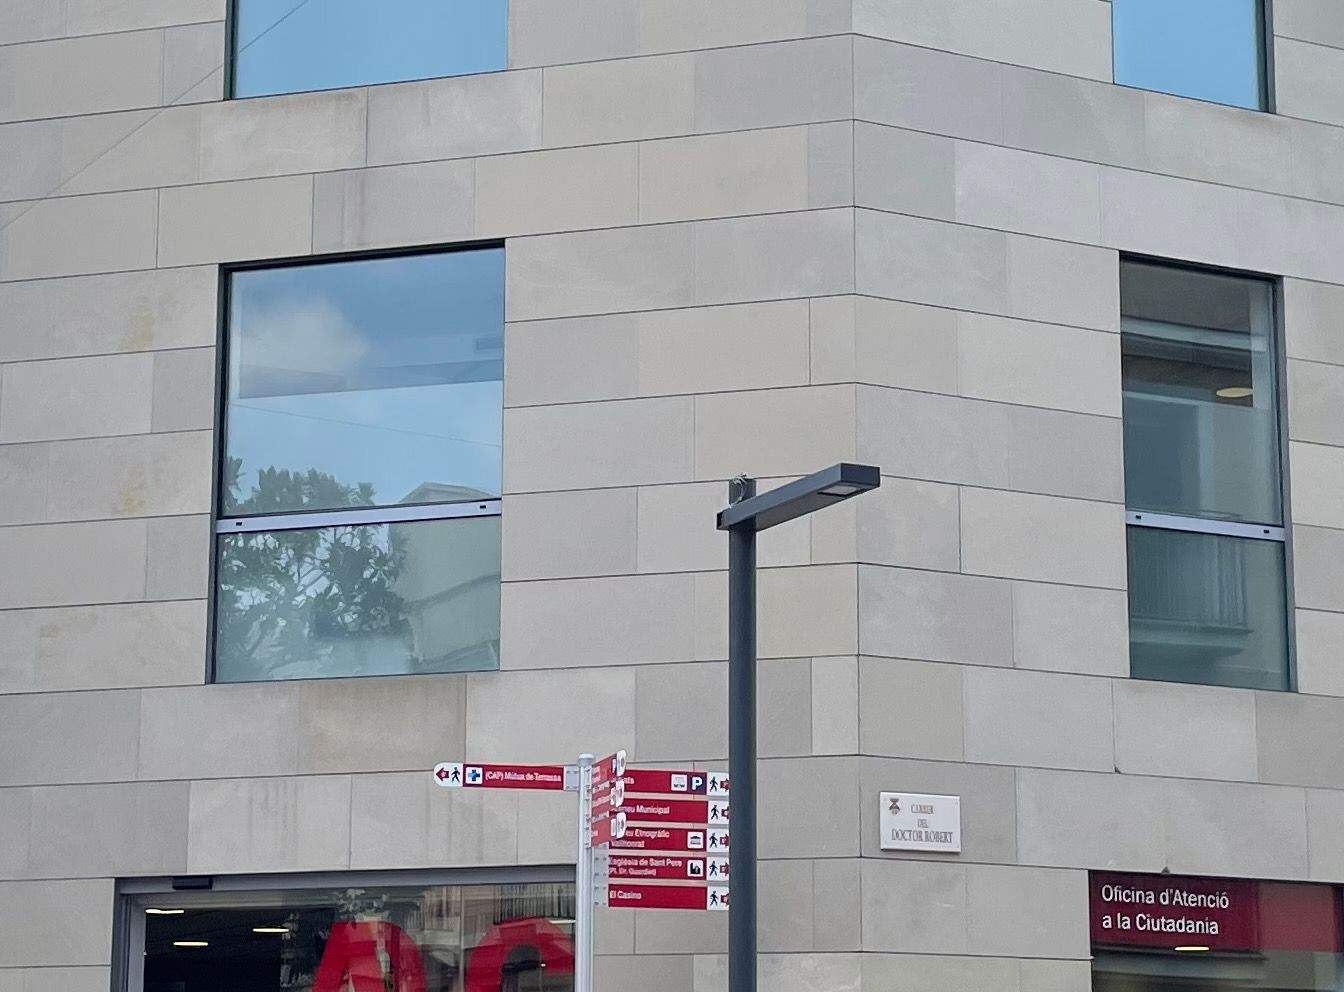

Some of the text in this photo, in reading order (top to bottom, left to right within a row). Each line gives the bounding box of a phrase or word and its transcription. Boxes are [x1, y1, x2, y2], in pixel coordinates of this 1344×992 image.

[636, 804, 670, 815] Municipal
[891, 829, 954, 843] DOCTOR ROBERT
[1101, 884, 1230, 909] Oficina d'Atenció
[1102, 912, 1219, 935] a la Ciutadania
